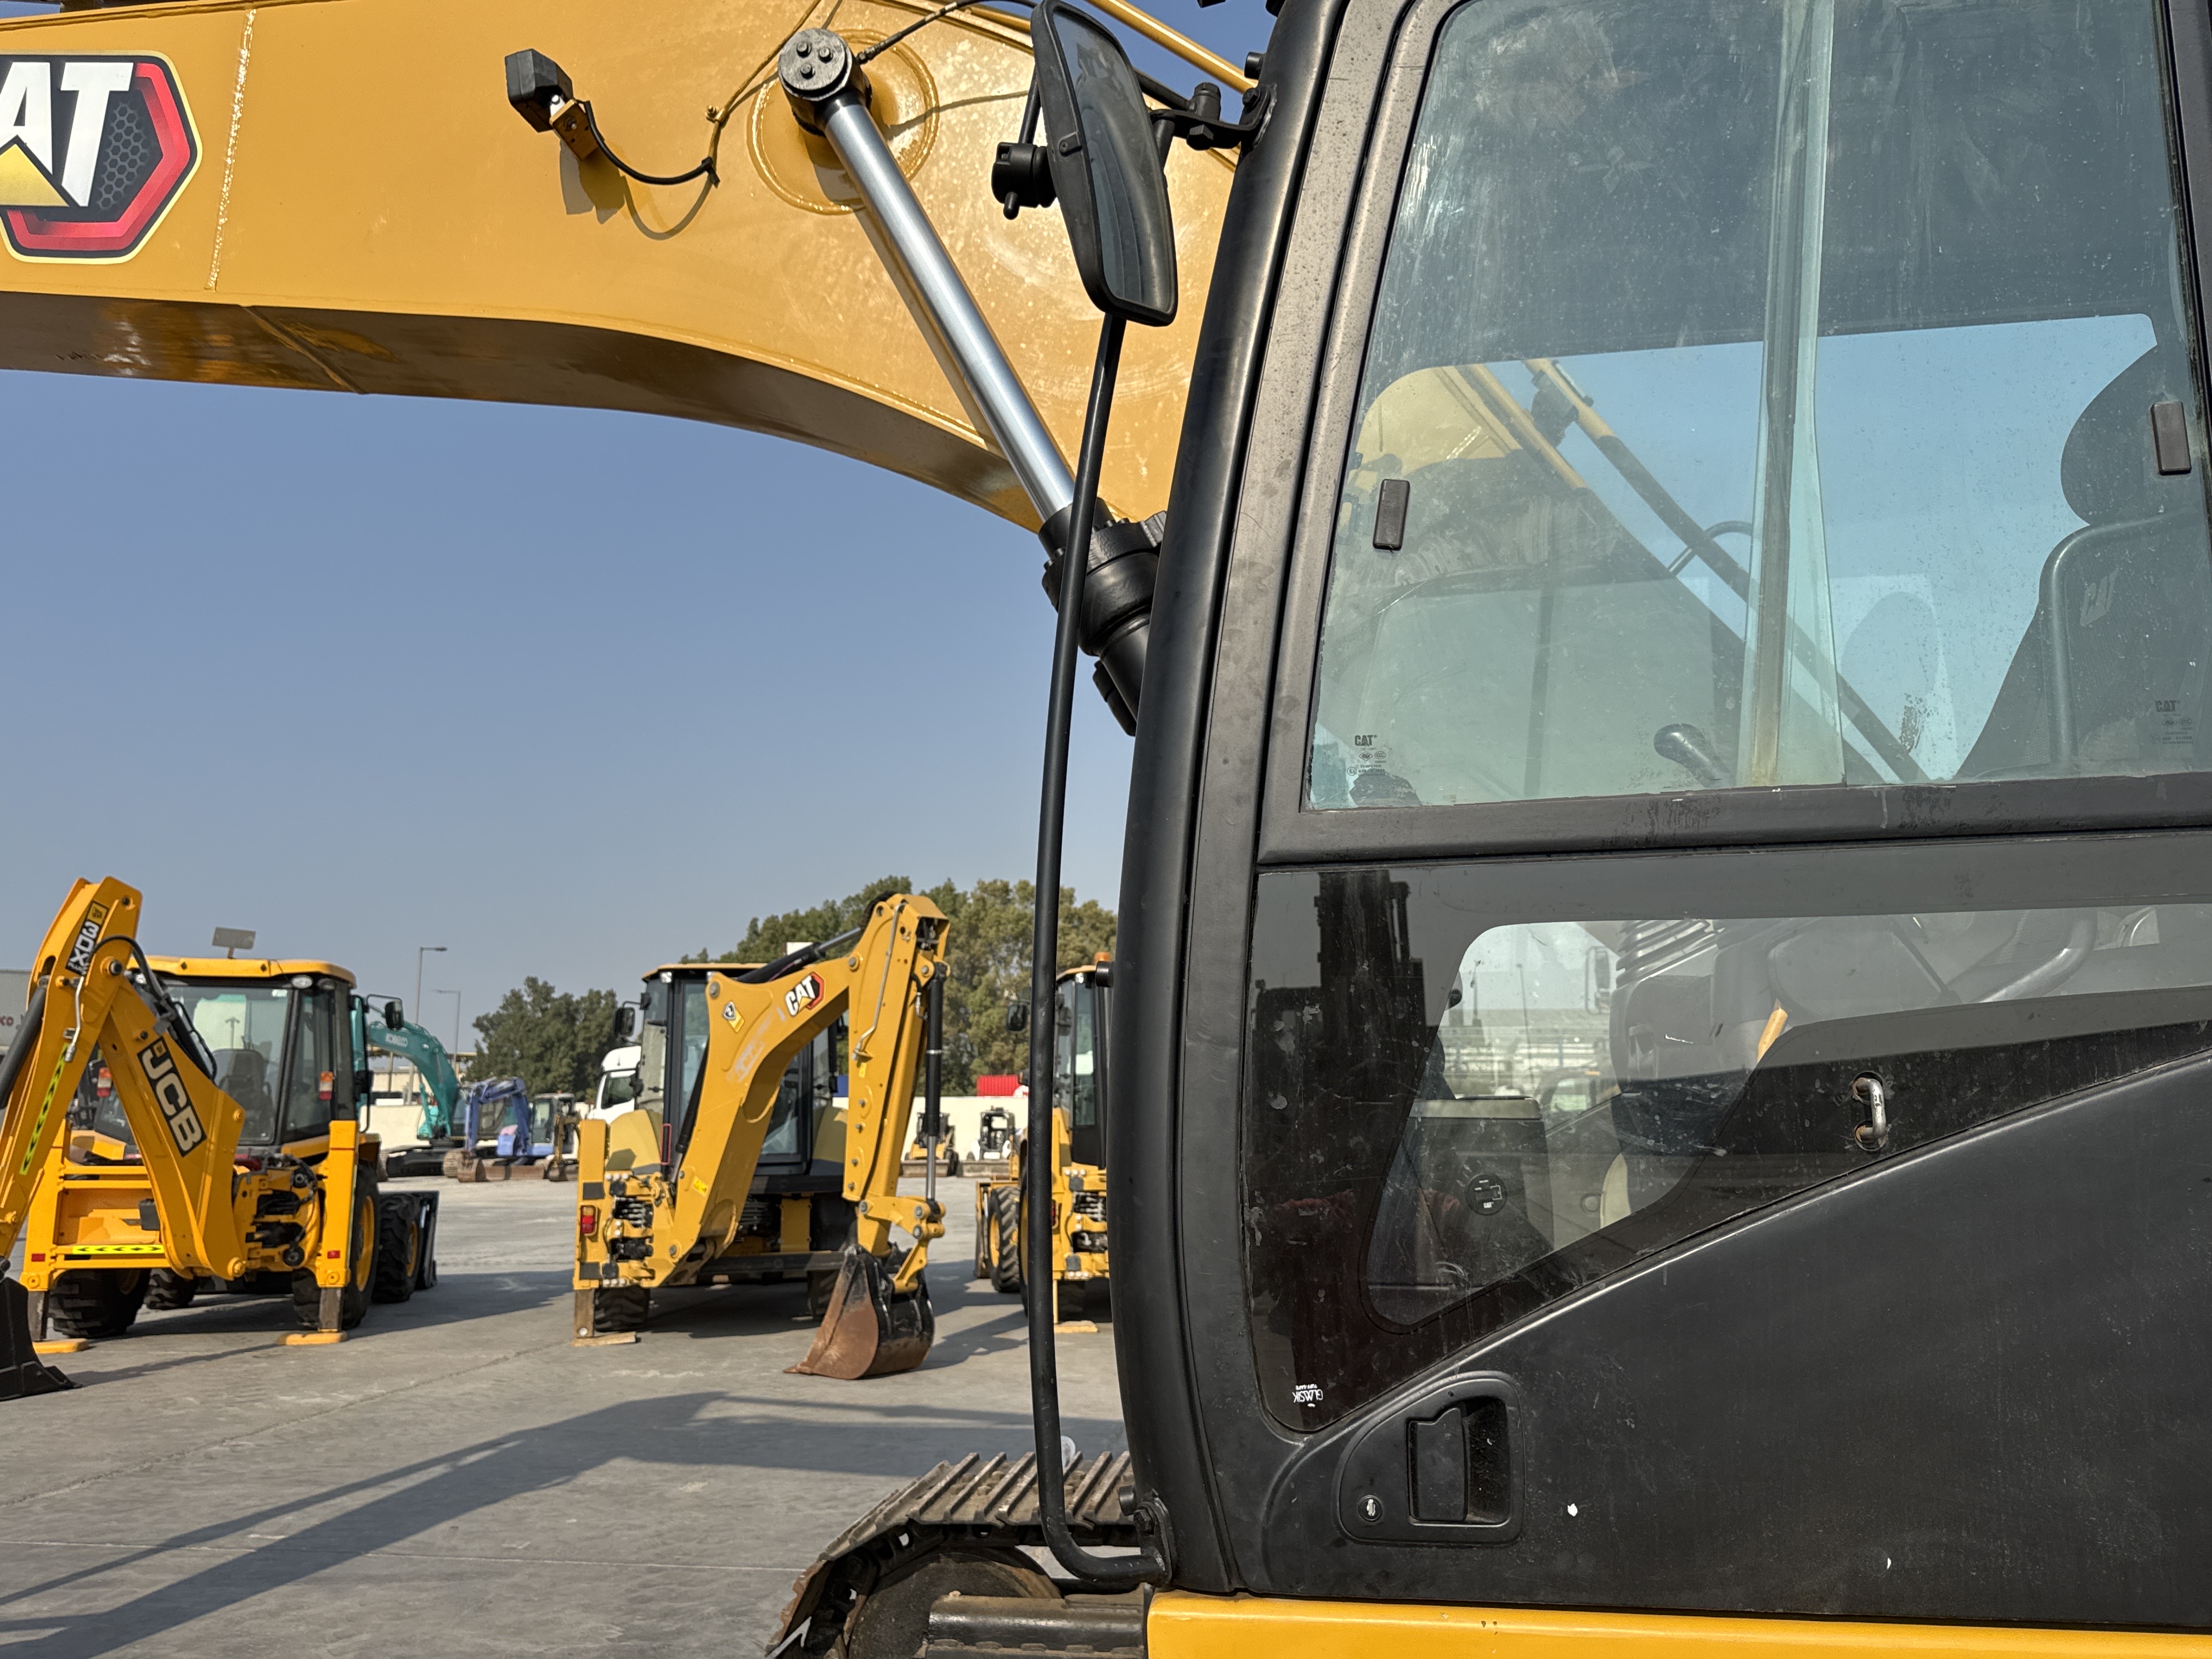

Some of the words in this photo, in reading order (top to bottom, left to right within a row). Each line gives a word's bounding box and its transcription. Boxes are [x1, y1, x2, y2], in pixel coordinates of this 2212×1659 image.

[2080, 568, 2119, 626] CAT
[785, 975, 815, 1015] CAT
[141, 1048, 203, 1151] JCB
